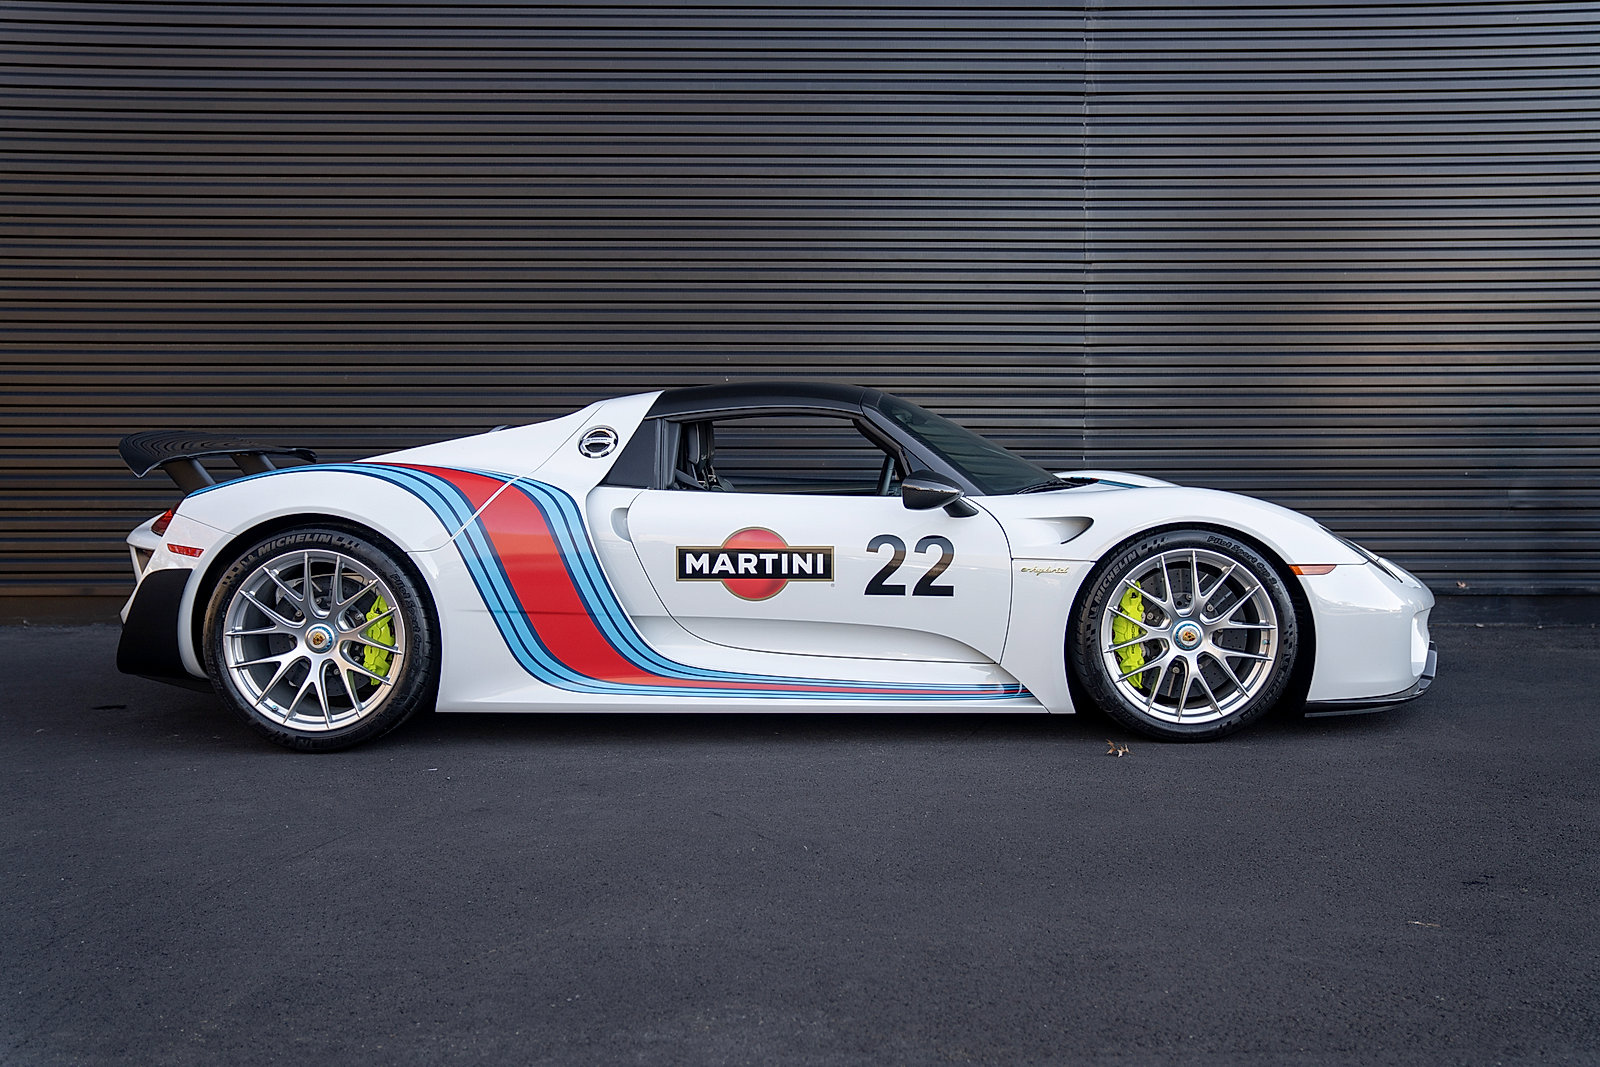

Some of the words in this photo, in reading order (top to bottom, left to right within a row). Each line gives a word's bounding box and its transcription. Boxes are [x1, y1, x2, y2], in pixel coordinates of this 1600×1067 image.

[258, 533, 332, 557] MICHELIN
[685, 553, 824, 574] MARTINI
[864, 534, 955, 597] 22
[1207, 535, 1232, 549] Pilot
[1232, 544, 1258, 565] Sport
[1256, 562, 1271, 578] Cup
[1094, 550, 1138, 605] MICHELIN
